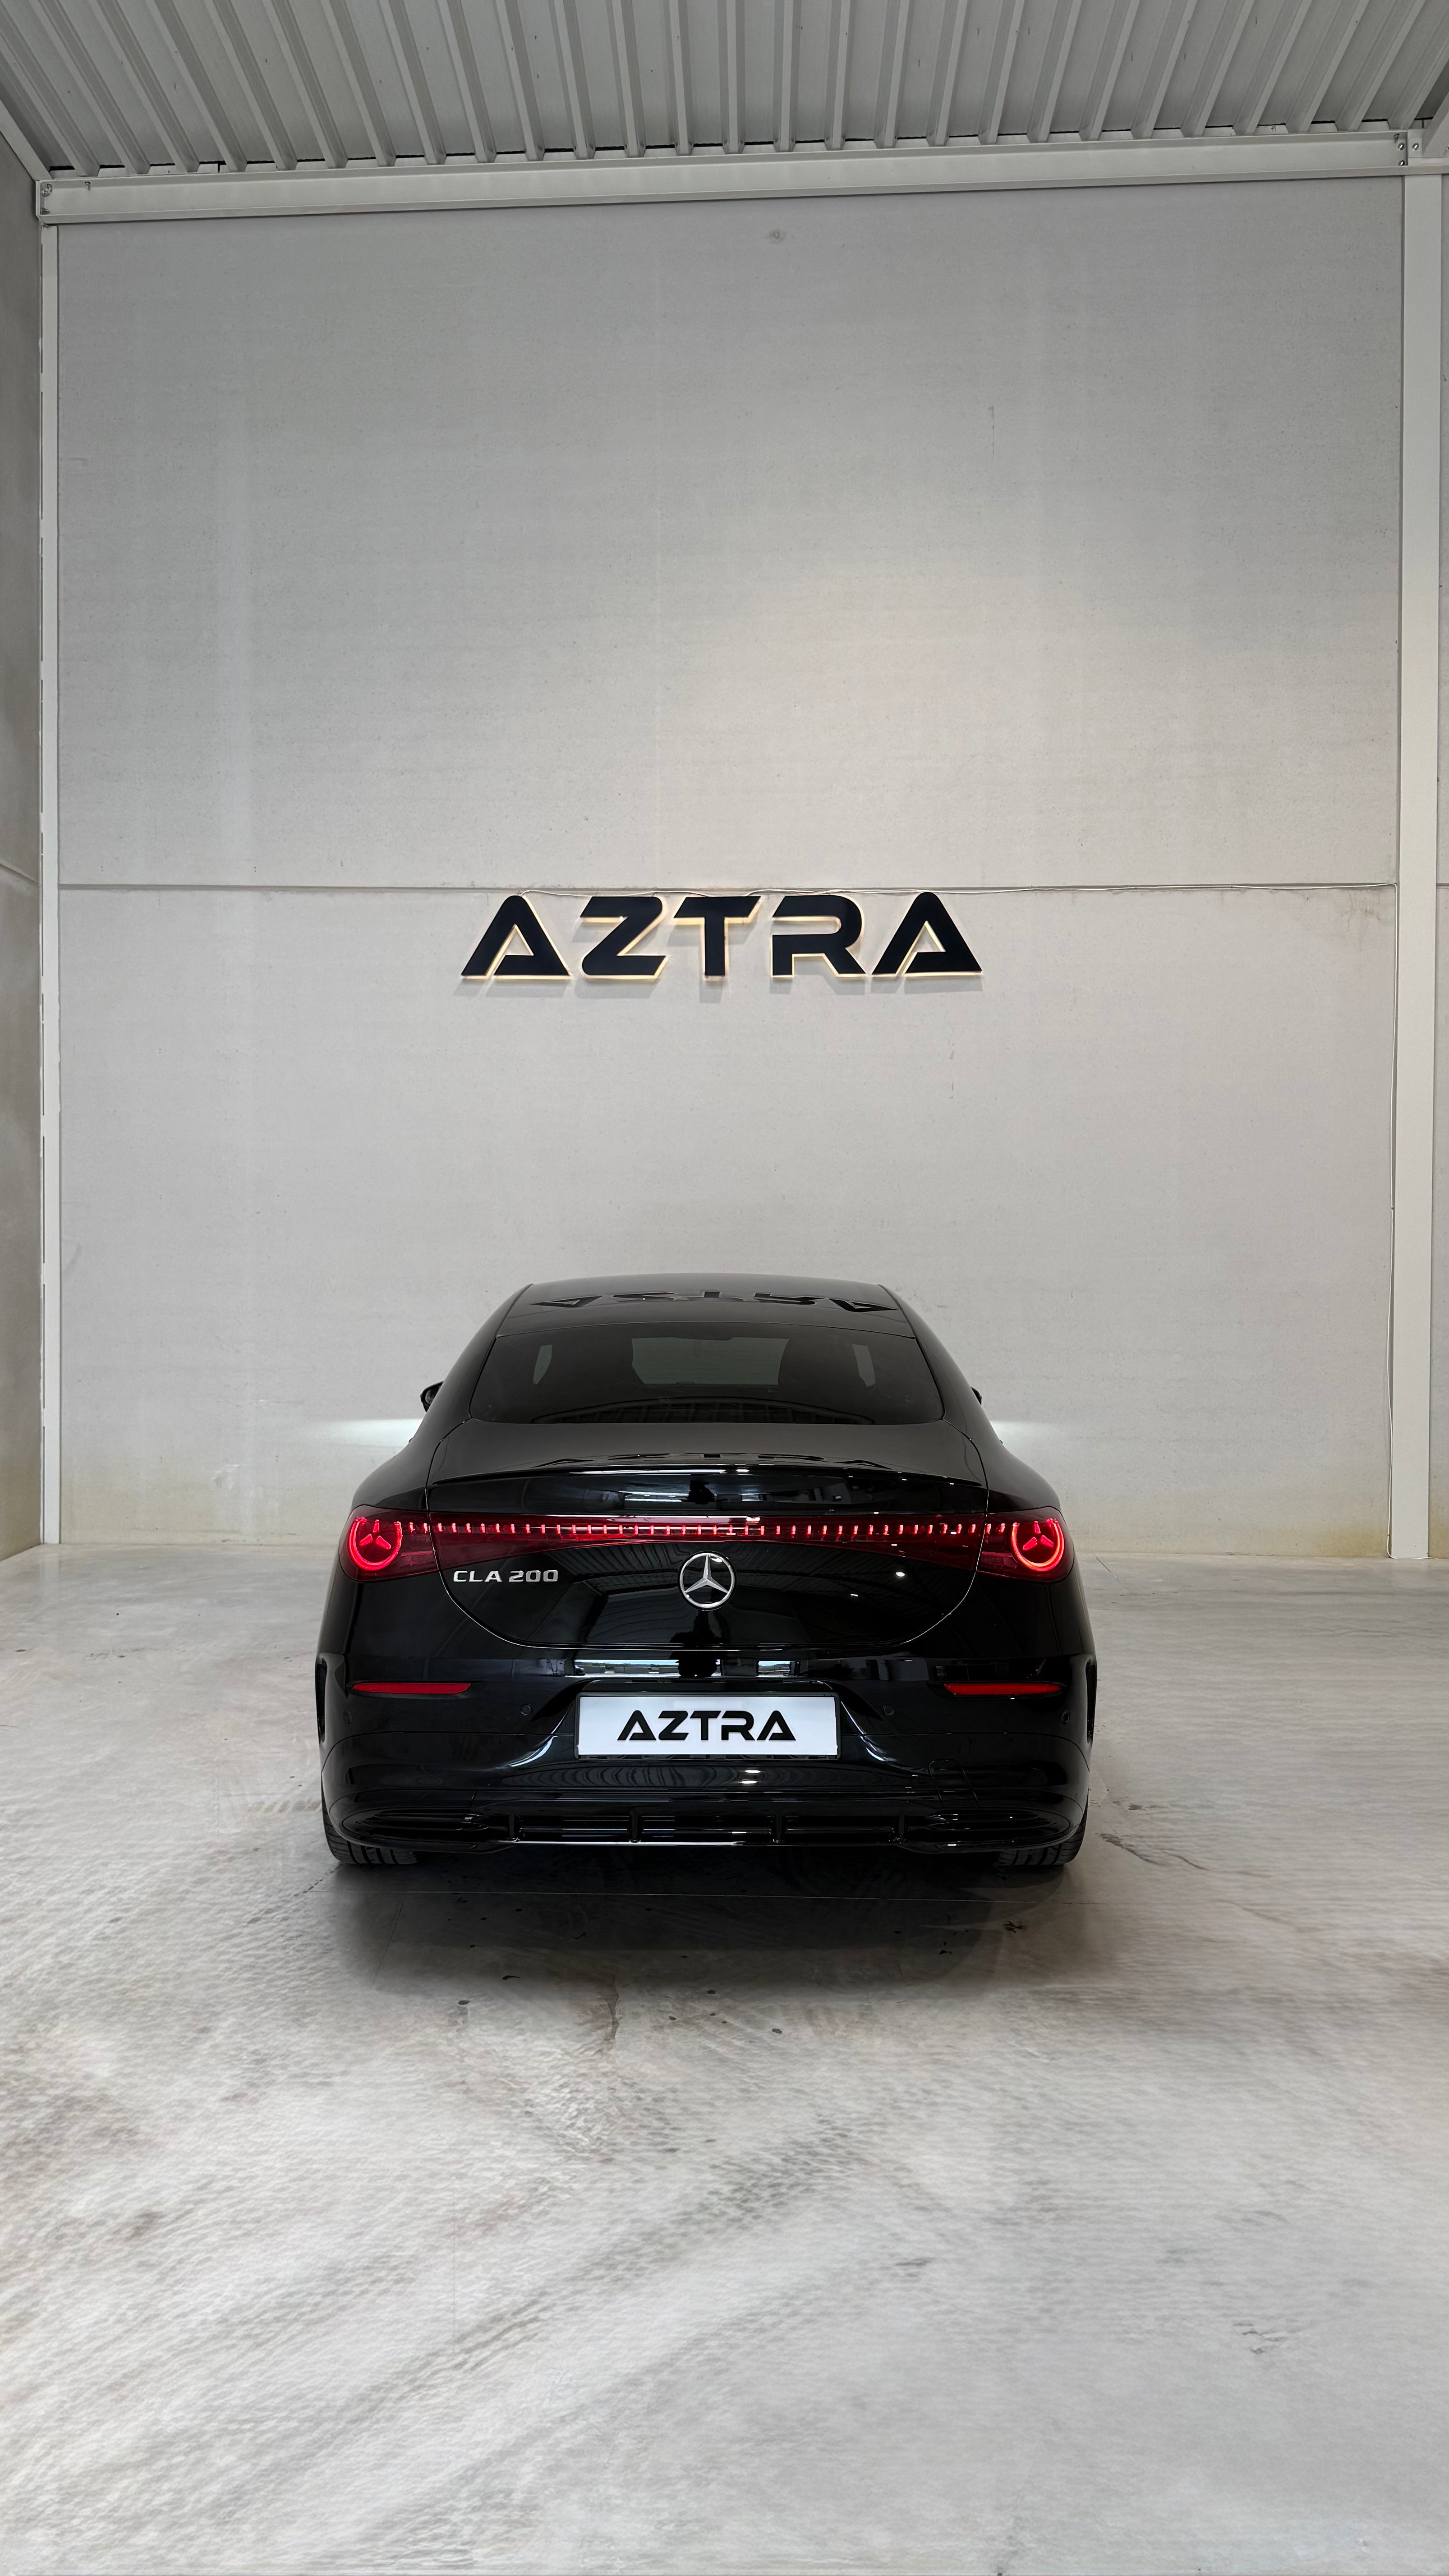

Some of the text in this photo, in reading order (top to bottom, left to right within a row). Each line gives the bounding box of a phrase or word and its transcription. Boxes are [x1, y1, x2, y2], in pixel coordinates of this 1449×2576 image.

[461, 892, 982, 977] AZTRA
[453, 1569, 558, 1582] CLA 200
[617, 1710, 796, 1741] AZTRA
